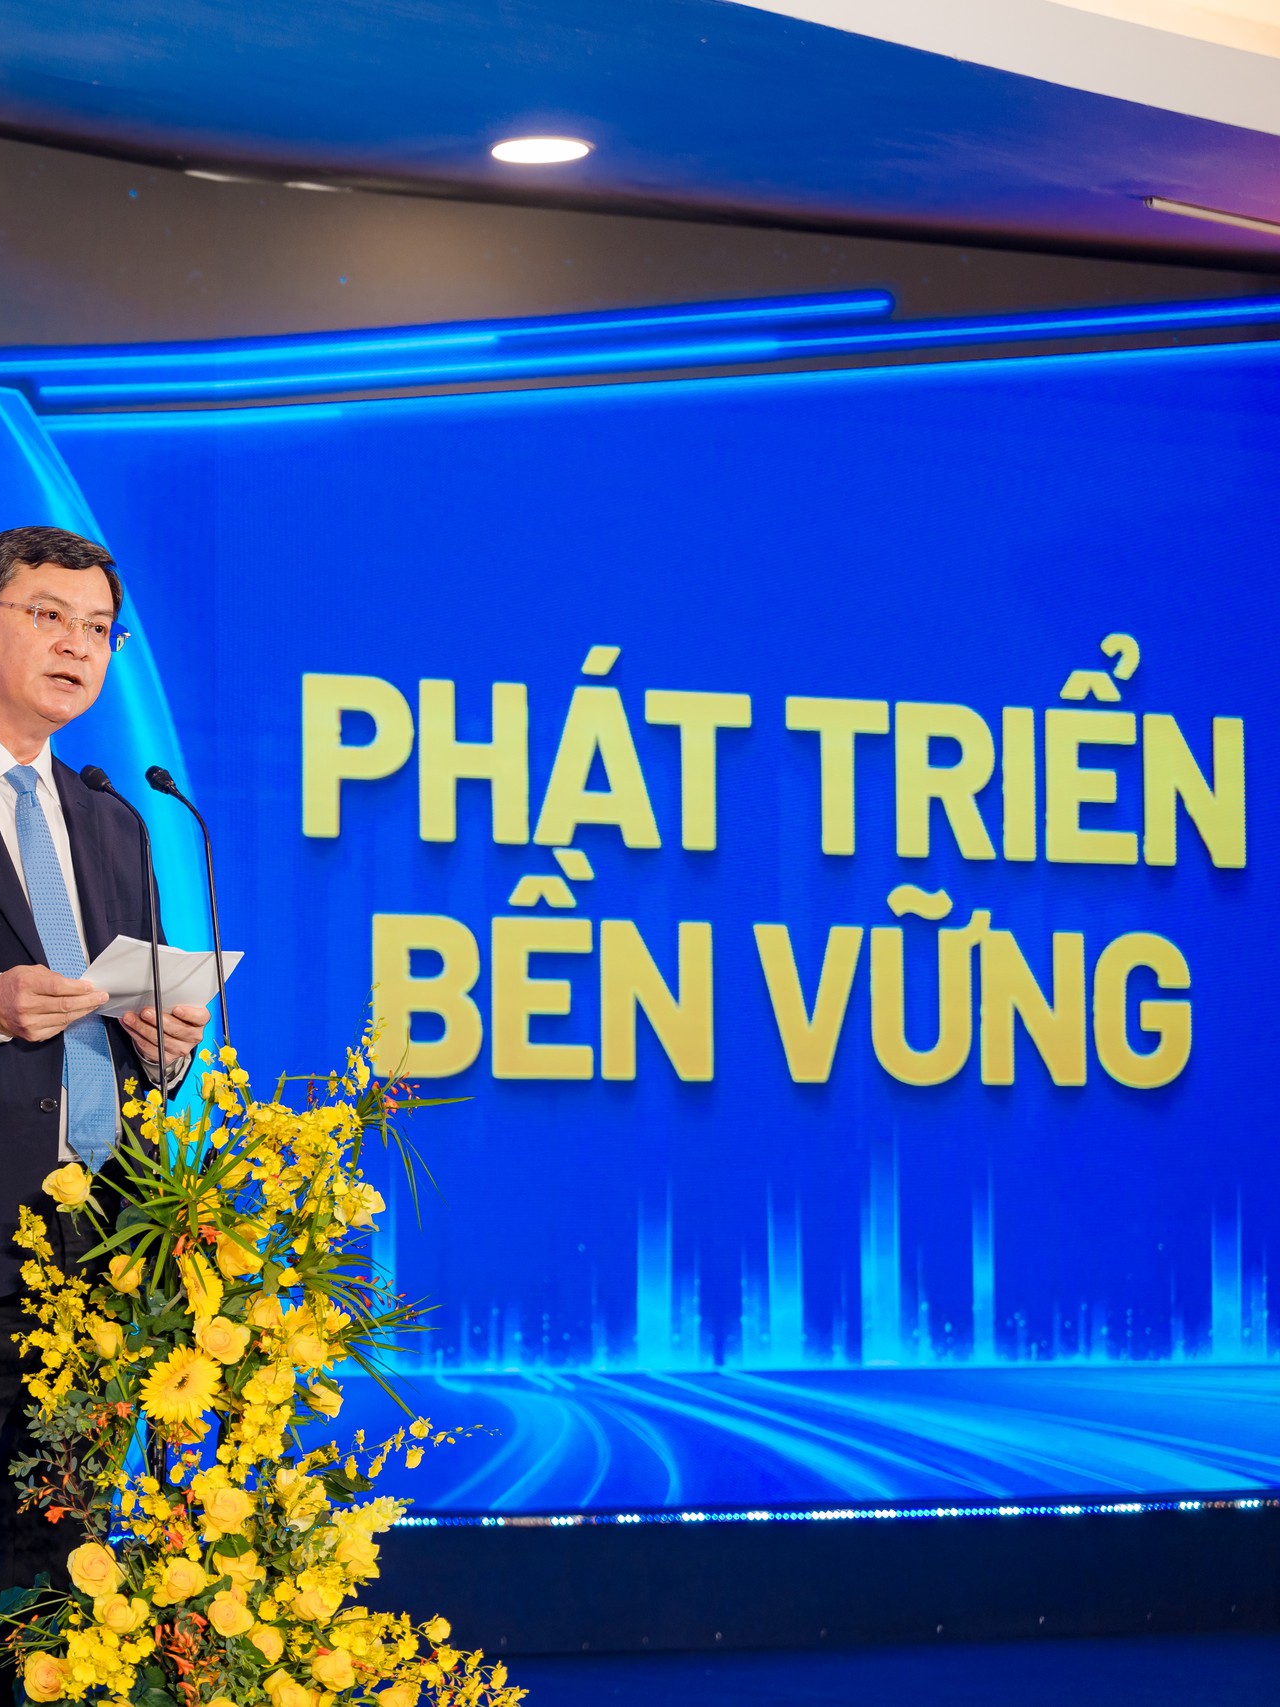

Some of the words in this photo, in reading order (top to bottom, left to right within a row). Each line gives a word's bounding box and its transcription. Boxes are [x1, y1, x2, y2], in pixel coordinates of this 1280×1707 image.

[301, 645, 752, 852] PHÁT
[785, 633, 1247, 868] TRIỂN
[371, 847, 716, 1081] BỀN
[752, 884, 1193, 1089] VỮNG
